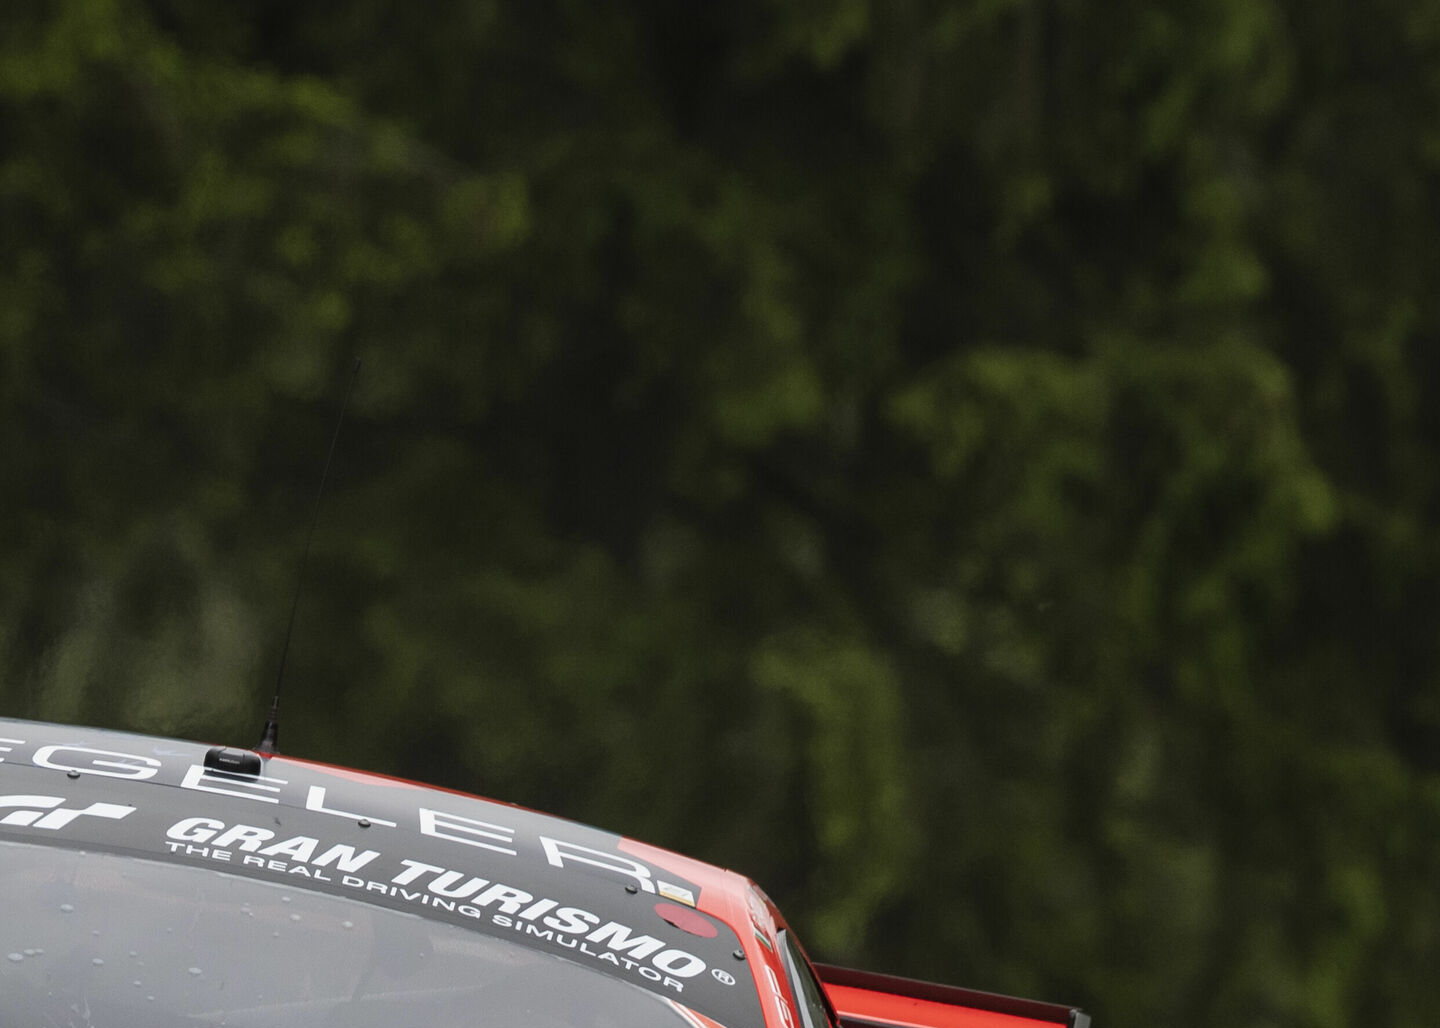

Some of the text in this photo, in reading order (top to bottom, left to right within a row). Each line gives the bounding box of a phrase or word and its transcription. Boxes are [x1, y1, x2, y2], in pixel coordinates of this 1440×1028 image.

[165, 816, 380, 873] GRAN
[165, 841, 685, 992] THE REAL DRIVING SIMULATOR
